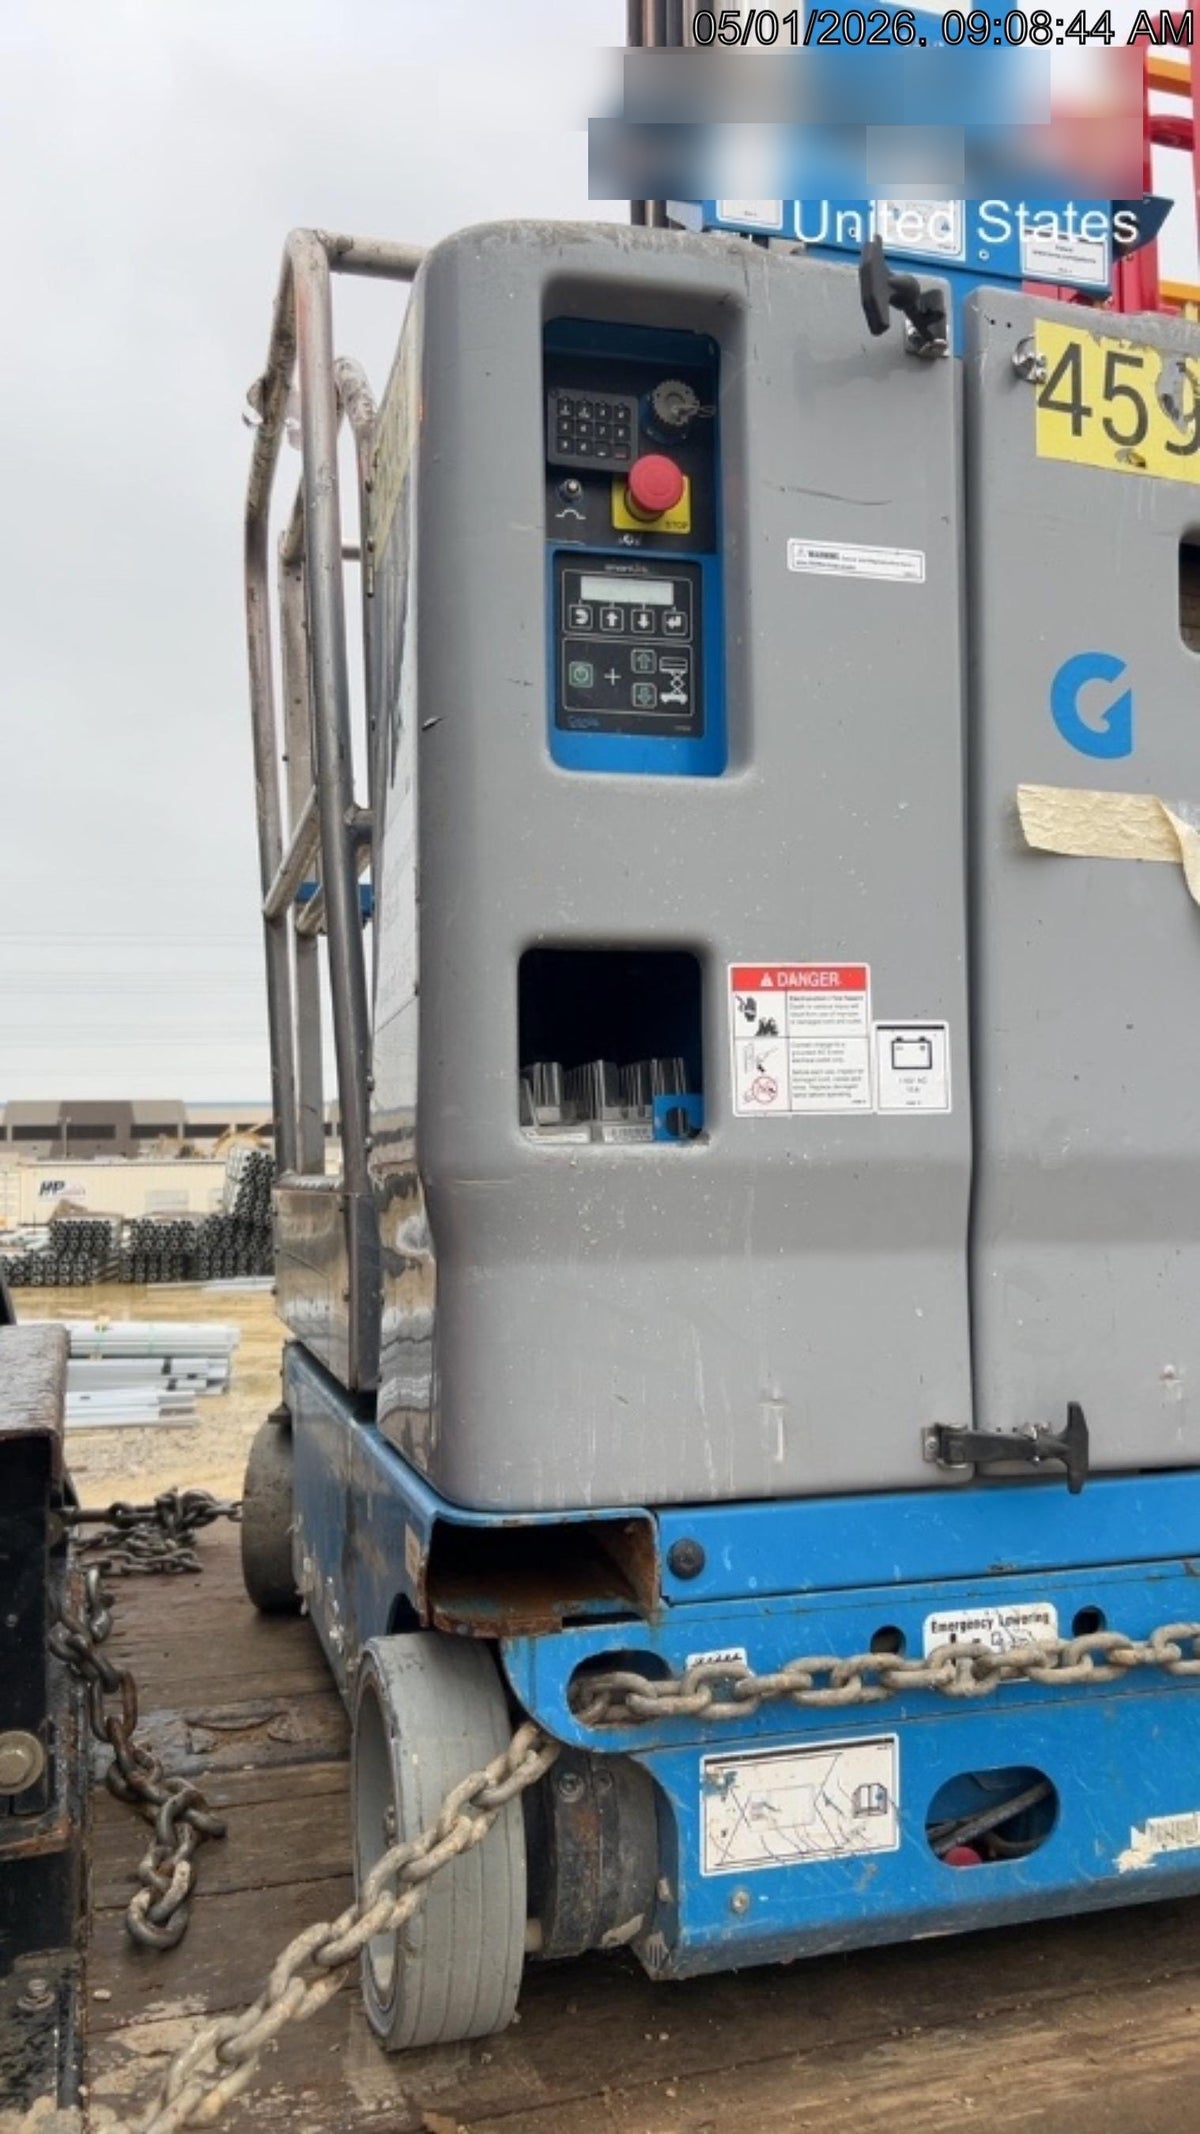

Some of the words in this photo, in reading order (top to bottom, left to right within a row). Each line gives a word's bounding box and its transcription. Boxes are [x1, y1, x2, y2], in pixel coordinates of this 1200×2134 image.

[777, 971, 840, 988] DANGER
[931, 1618, 994, 1634] Emergency
[998, 1612, 1050, 1628] Lowering
